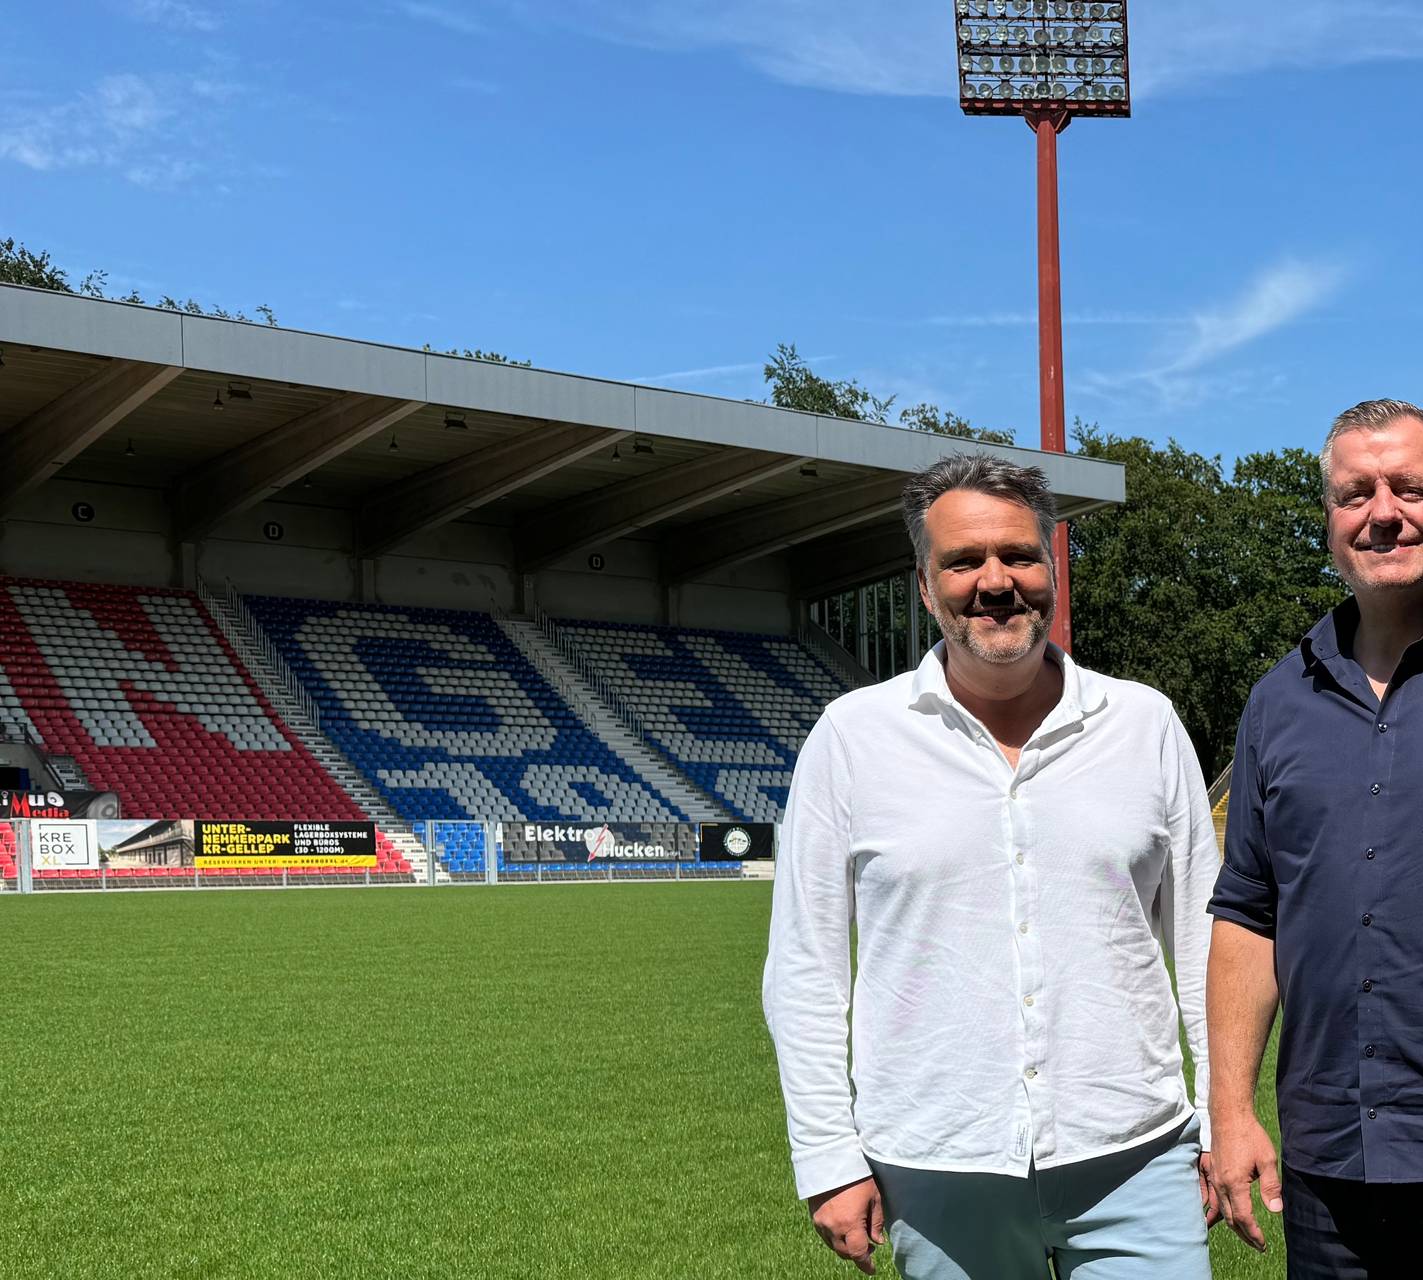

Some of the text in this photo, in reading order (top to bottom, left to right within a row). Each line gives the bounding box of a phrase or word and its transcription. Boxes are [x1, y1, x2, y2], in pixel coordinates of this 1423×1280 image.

[202, 824, 251, 834] UNTER-
[525, 825, 595, 842] Elektro
[39, 832, 72, 843] KRE
[202, 834, 290, 844] NEHMERPARK
[294, 831, 368, 839] LAGERBOXSYSTEME
[313, 838, 340, 846] BÜROS
[40, 844, 75, 855] BOX
[203, 844, 275, 854] KR-GELLEP
[41, 855, 61, 866] XL
